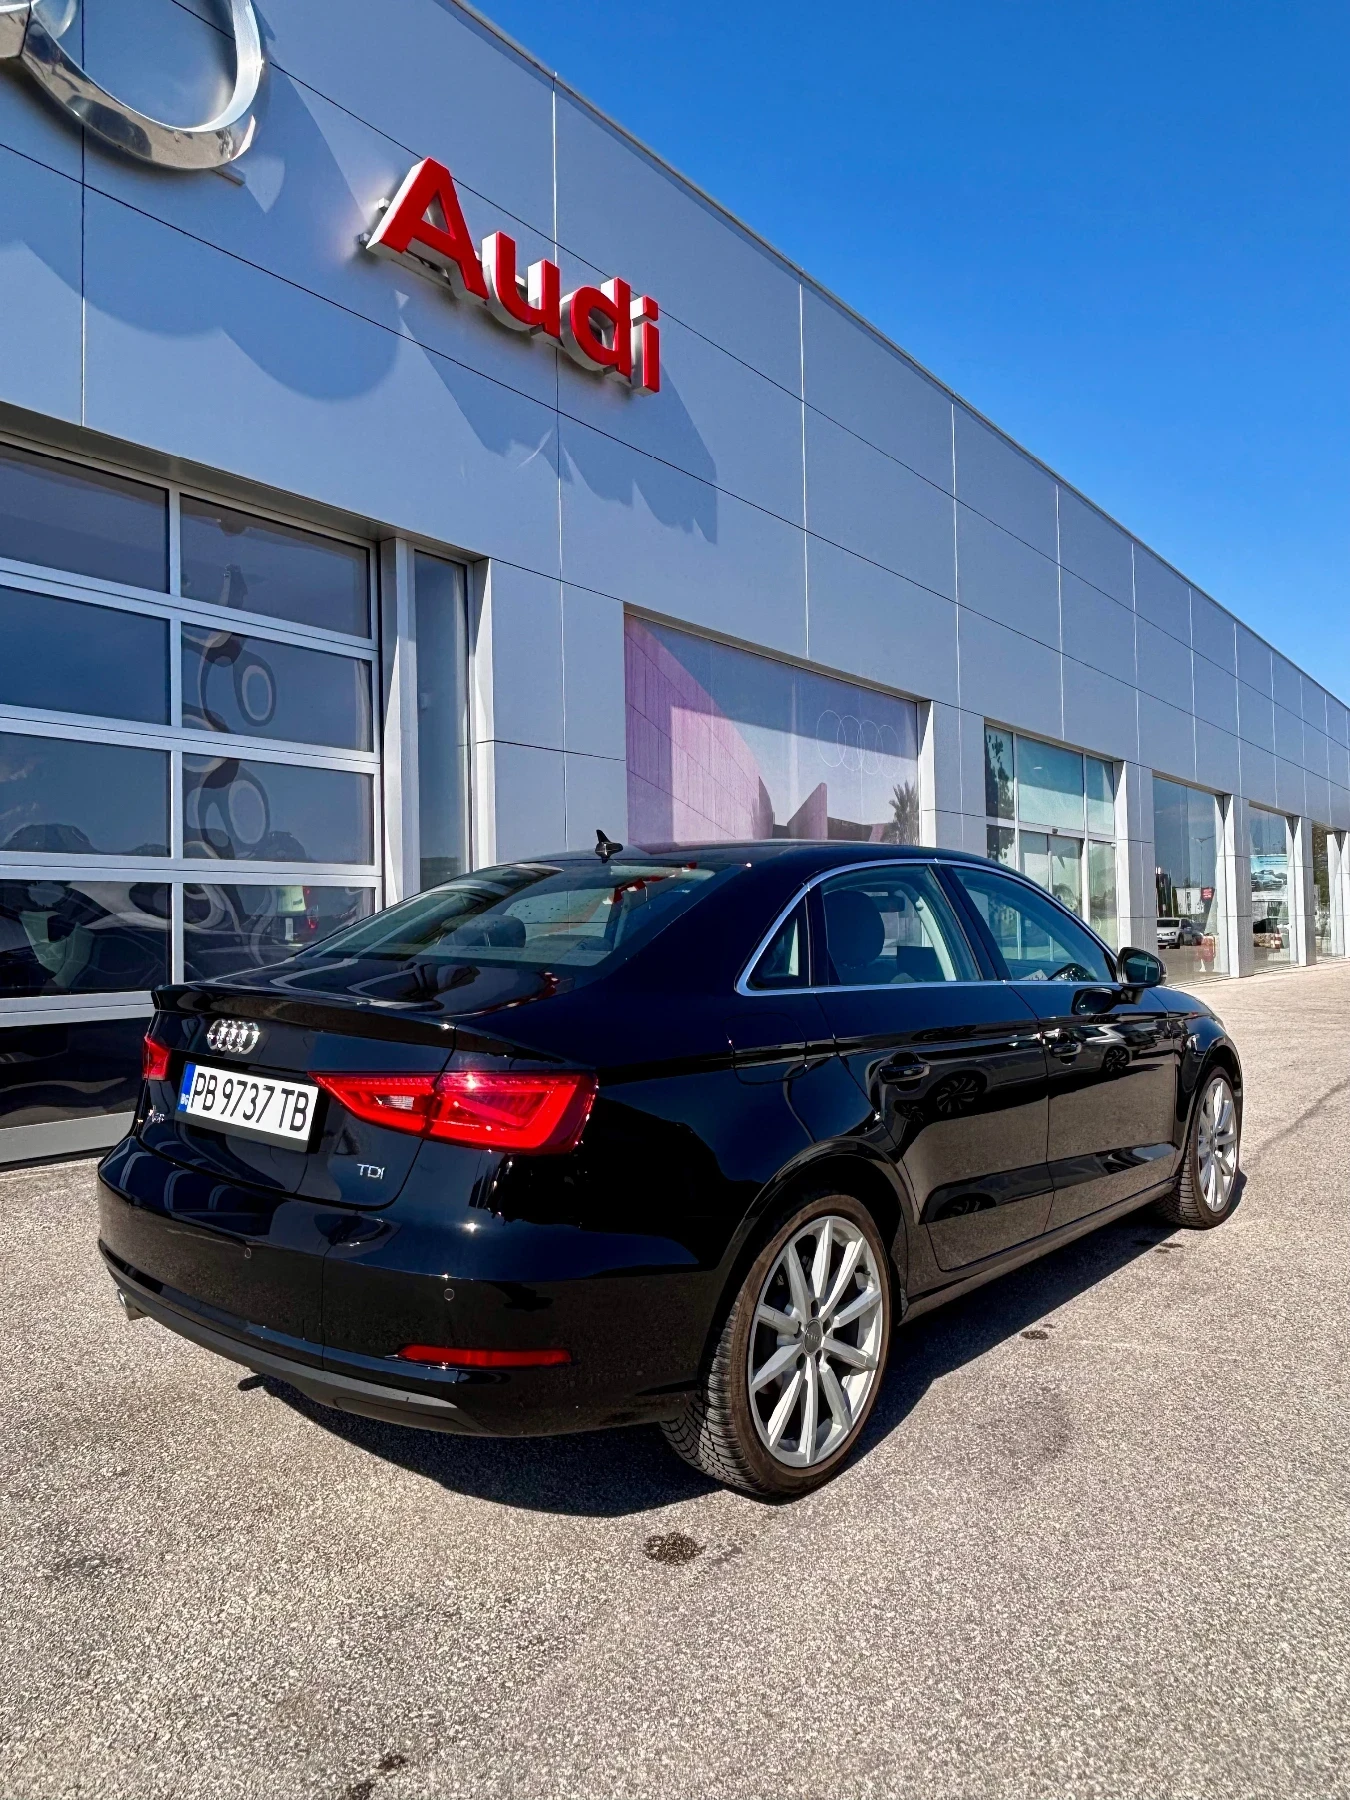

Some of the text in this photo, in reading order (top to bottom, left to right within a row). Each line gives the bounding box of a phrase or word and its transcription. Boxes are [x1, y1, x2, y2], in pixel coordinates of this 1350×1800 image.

[368, 157, 660, 395] Audi
[190, 1072, 309, 1132] PB 9737 TB
[356, 1163, 385, 1180] TDI
